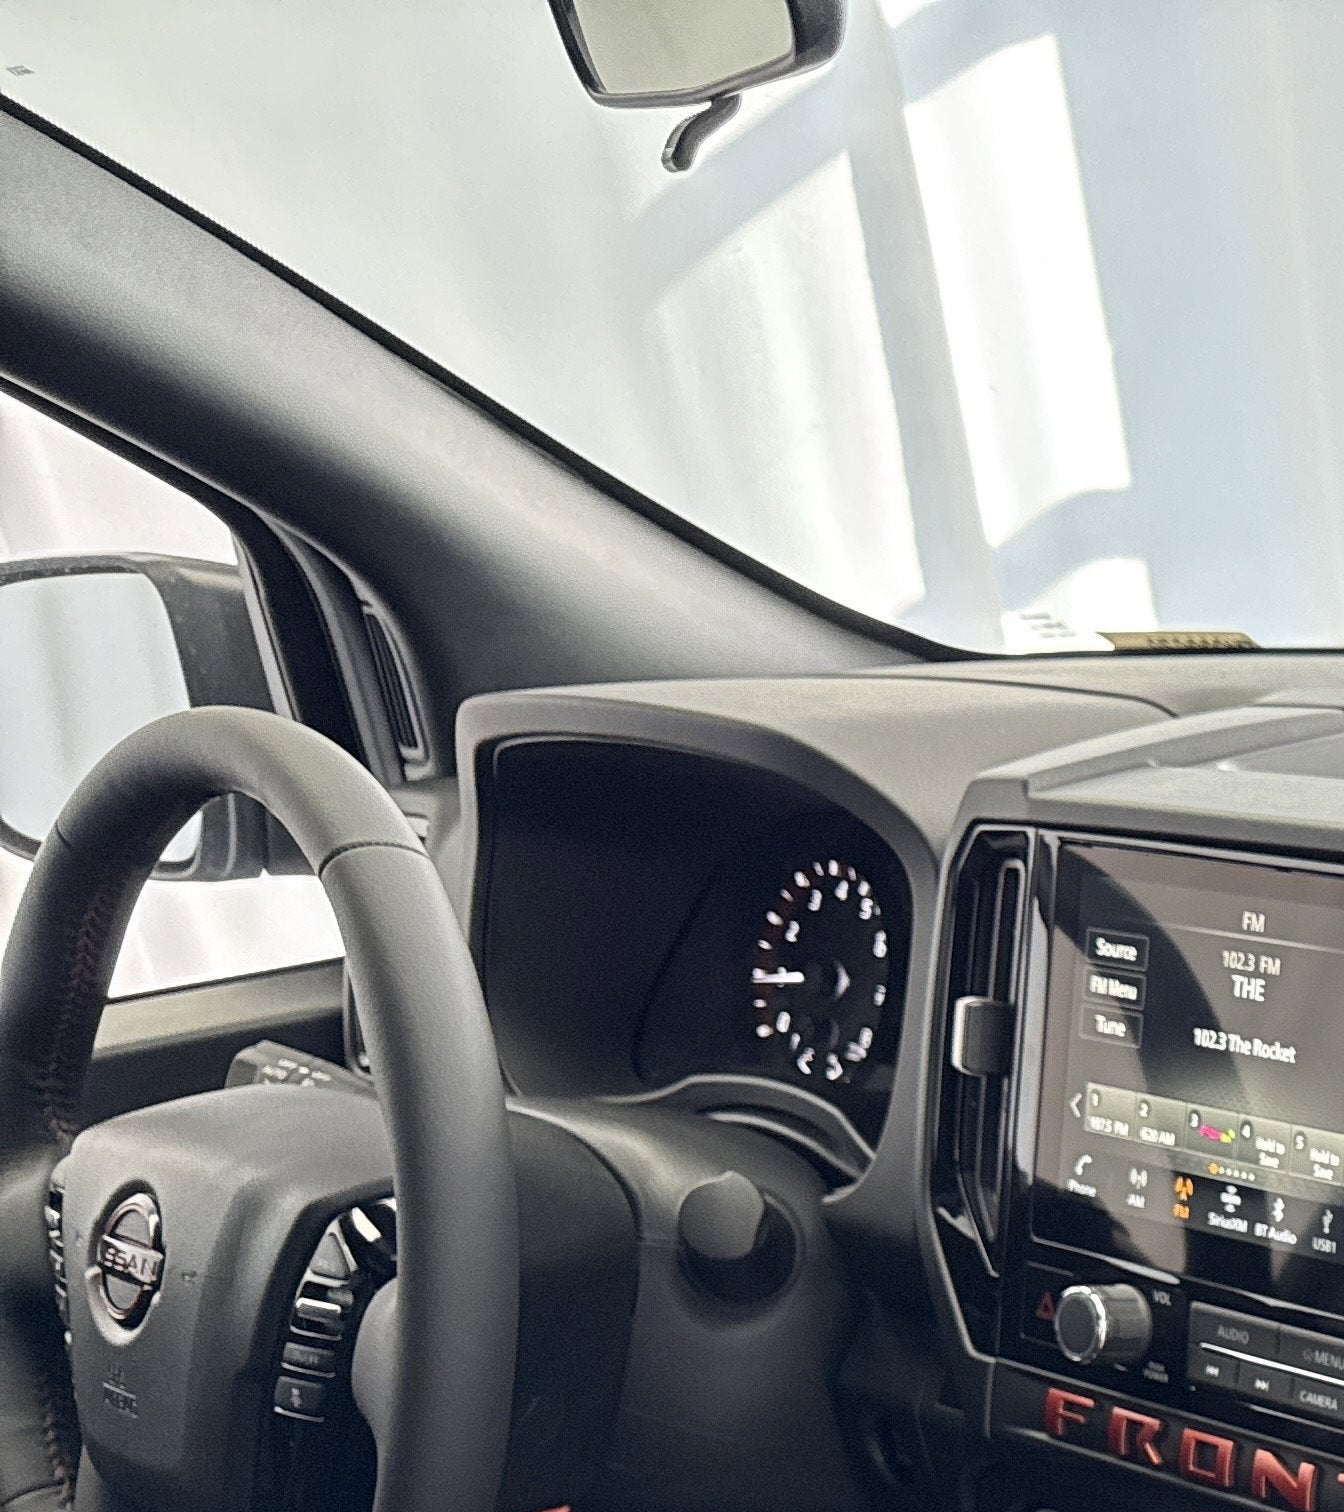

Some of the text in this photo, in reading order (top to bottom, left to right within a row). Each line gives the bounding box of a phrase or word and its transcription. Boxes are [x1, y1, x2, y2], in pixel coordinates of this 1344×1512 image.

[1242, 911, 1265, 933] FM
[1096, 937, 1138, 962] Source
[1222, 950, 1281, 976] 102.3 FM
[1089, 975, 1138, 1001] FM Menu
[1231, 974, 1266, 1002] THE
[1094, 1014, 1127, 1038] Tune
[1193, 1027, 1297, 1064] 102.3 The Rocket
[1139, 1102, 1149, 1118] 2
[1158, 1131, 1176, 1147] AM
[1255, 1136, 1286, 1155] Hold to
[1295, 1134, 1304, 1150] 5
[1258, 1151, 1280, 1169] Save
[1309, 1147, 1340, 1167] Hold to
[1313, 1163, 1334, 1181] Save
[1126, 1193, 1146, 1209] AM
[1172, 1202, 1190, 1220] FM
[1254, 1222, 1298, 1246] BT Audio
[1312, 1236, 1337, 1254] USB1
[1152, 1289, 1172, 1307] VOL
[1217, 1324, 1250, 1345] AUDIO
[1299, 1390, 1338, 1411] CAMERA
